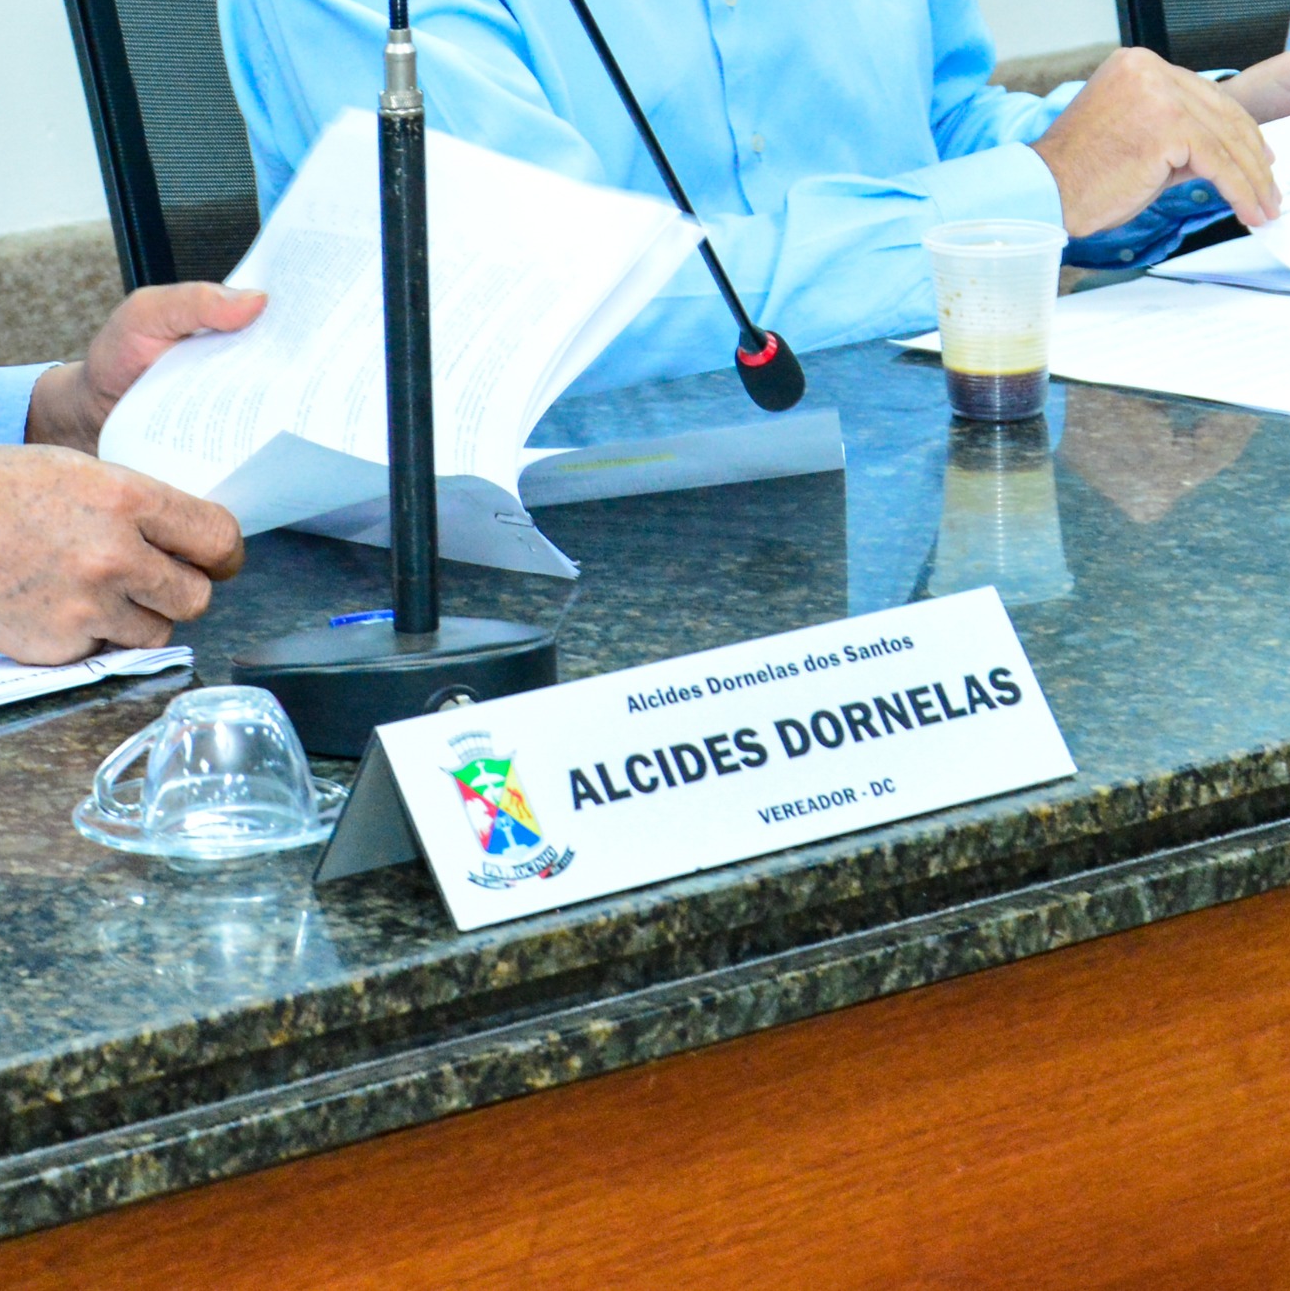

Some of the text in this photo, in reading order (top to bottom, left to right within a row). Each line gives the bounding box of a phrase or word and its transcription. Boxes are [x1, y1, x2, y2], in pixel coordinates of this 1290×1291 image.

[627, 633, 915, 714] Alcides Dornelas dos Santos
[568, 667, 1023, 811] ALCIDES DORNELAS
[757, 787, 858, 825] VEREADOR
[869, 778, 897, 795] DC
